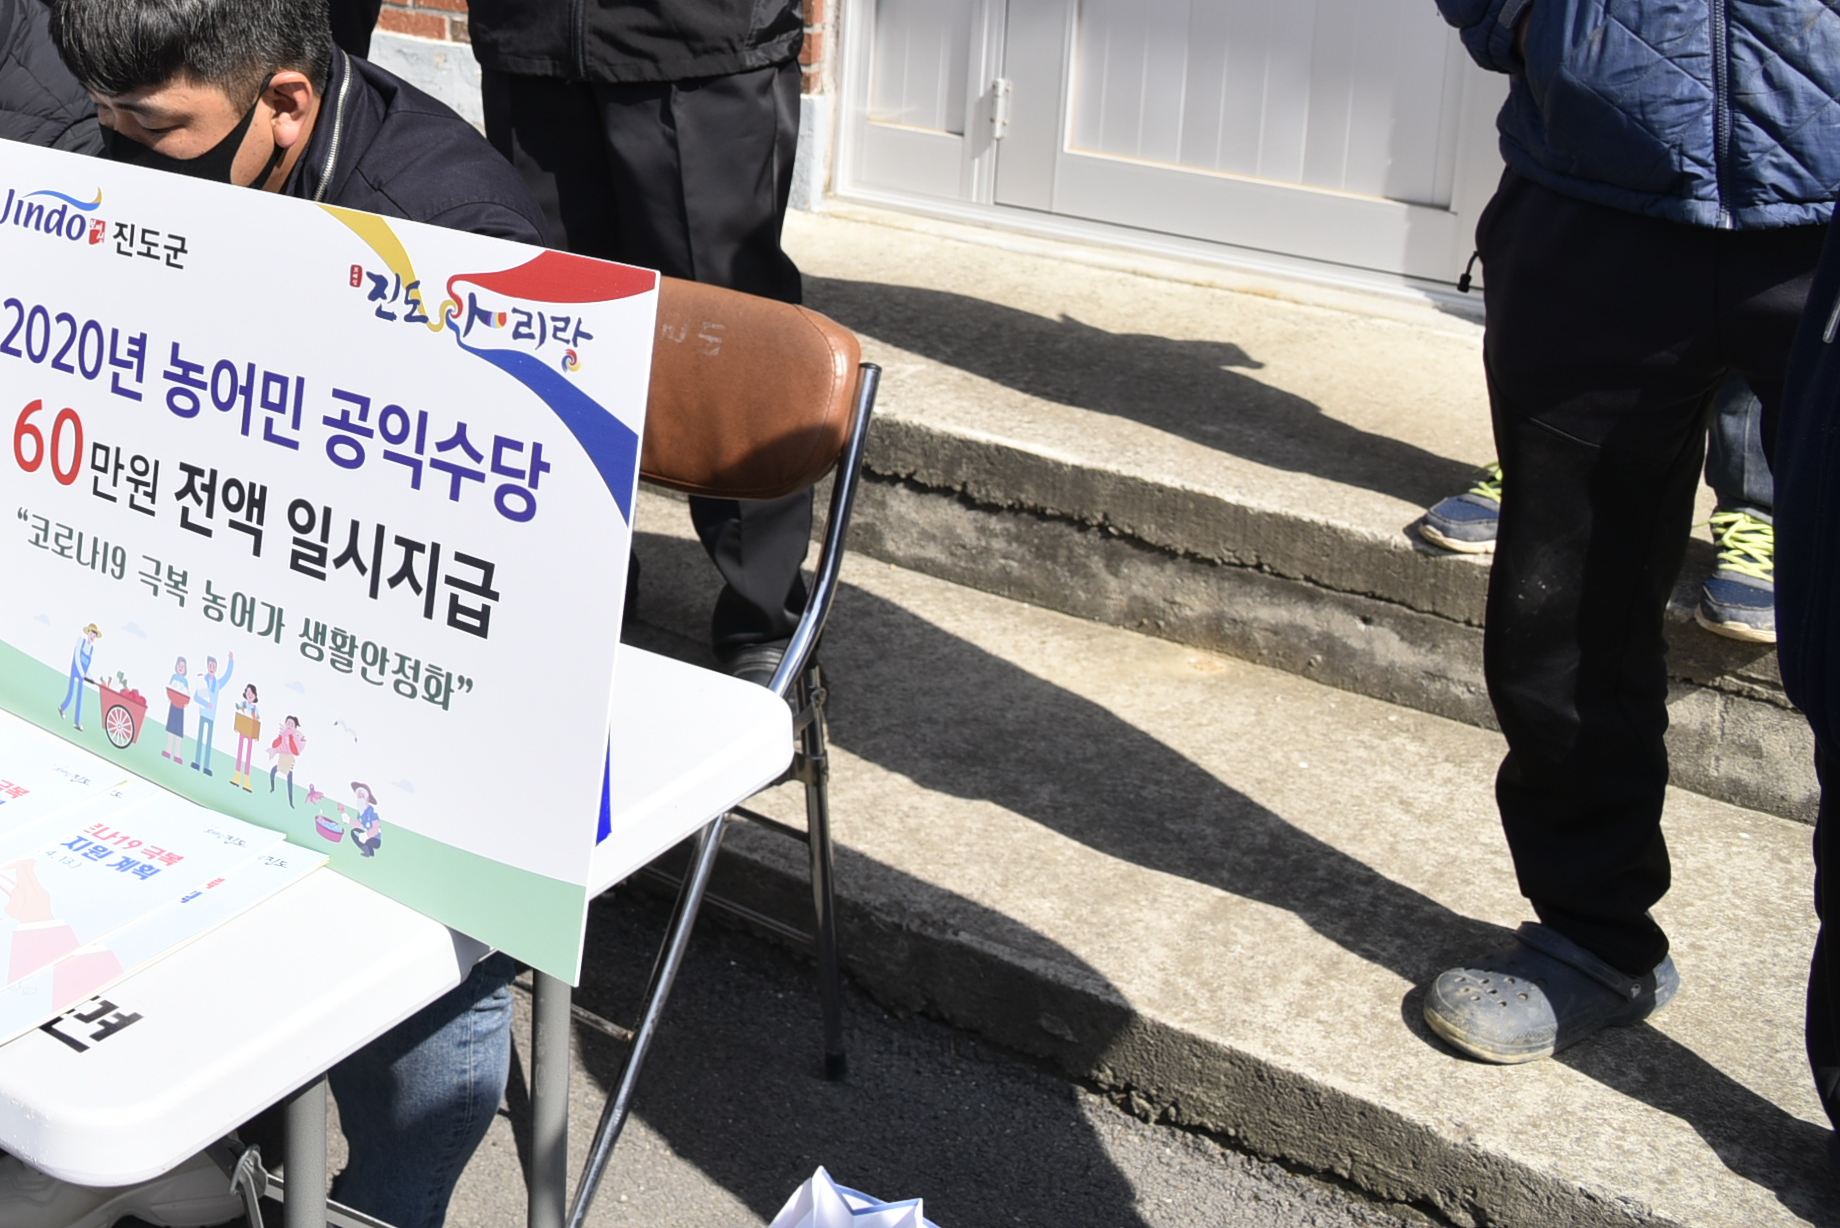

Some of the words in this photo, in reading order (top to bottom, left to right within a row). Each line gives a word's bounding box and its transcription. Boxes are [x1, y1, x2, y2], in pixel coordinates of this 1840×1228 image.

[112, 221, 188, 270] 진도군
[162, 340, 306, 452] 농어민
[321, 385, 552, 524] 공익수당
[174, 460, 269, 559] 전액
[286, 496, 502, 640] 일시지급
[137, 553, 190, 609] 극복
[201, 579, 288, 645] 농어가
[106, 855, 162, 881] 계획
[140, 844, 185, 867] 극복
